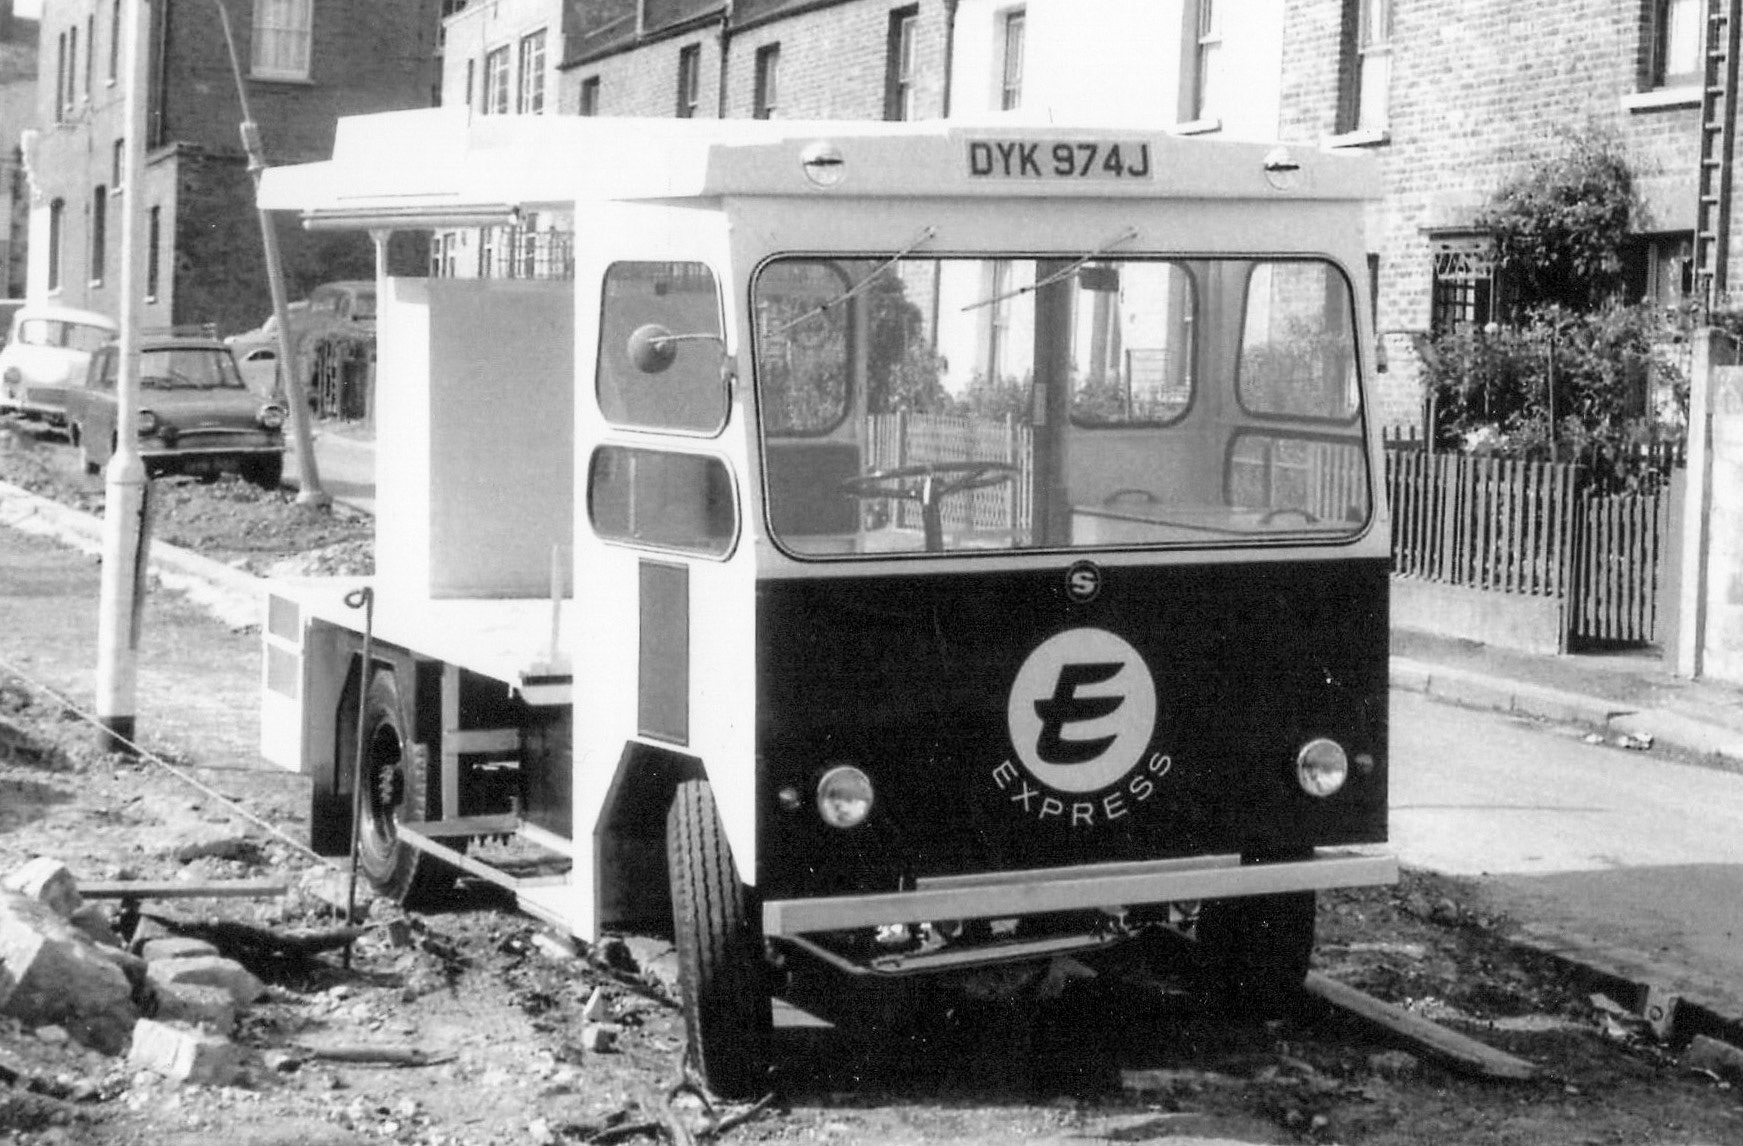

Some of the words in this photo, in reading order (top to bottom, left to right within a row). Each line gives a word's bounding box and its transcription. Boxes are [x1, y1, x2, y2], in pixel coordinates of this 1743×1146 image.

[970, 142, 1042, 176] DYK
[1052, 143, 1149, 177] 974J
[1072, 571, 1095, 594] S
[1034, 661, 1126, 766] E
[992, 752, 1172, 826] EXPRESS
